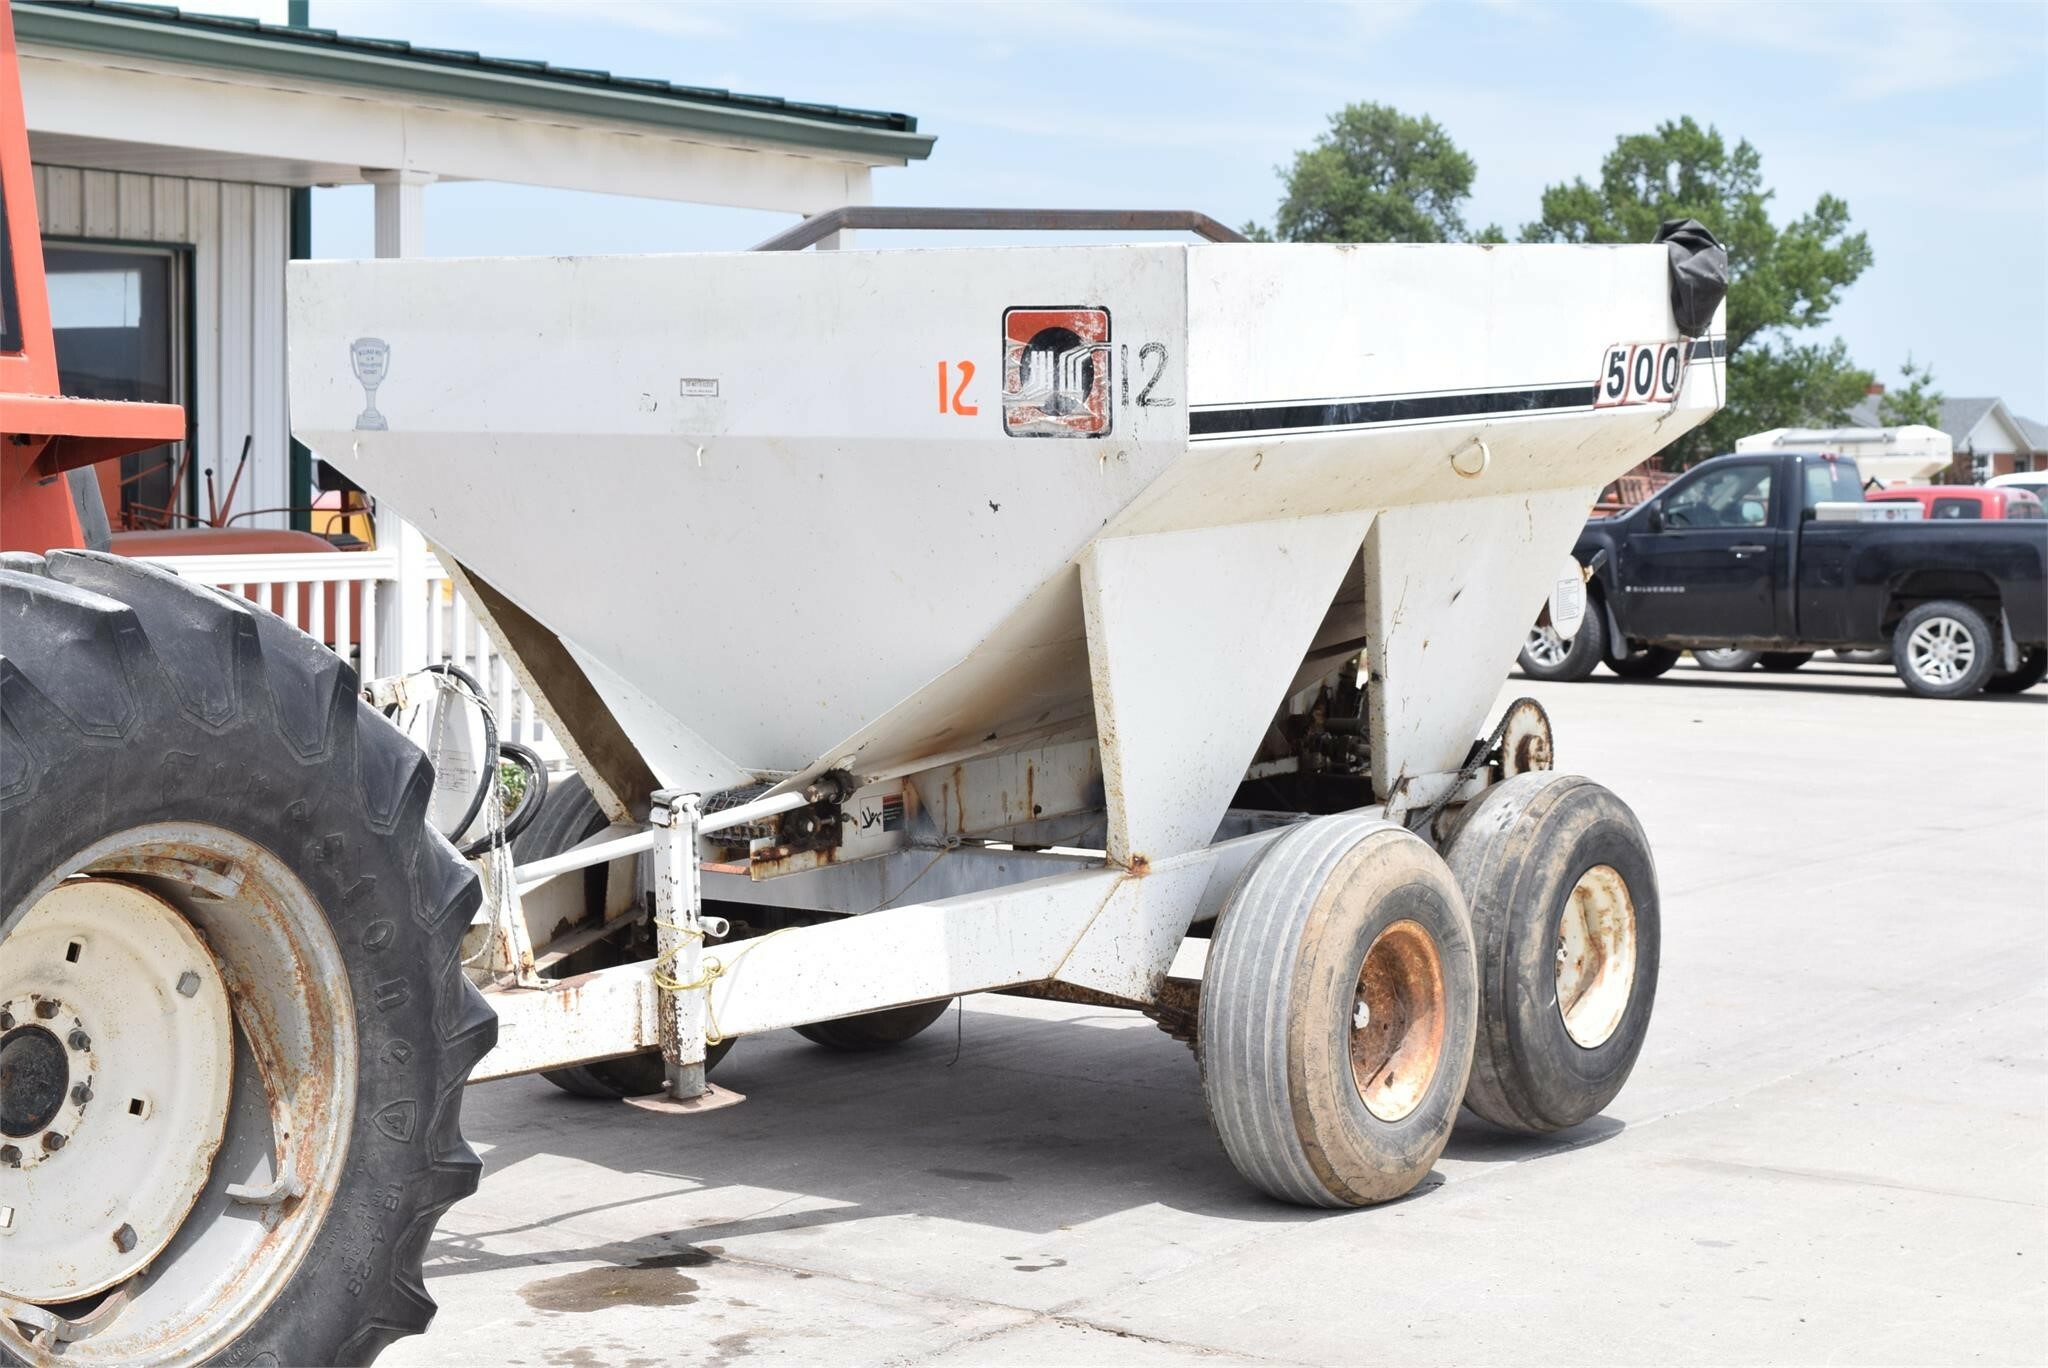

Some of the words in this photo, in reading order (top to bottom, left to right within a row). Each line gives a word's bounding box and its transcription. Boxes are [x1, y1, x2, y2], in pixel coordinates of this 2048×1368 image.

[937, 360, 978, 416] 12
[1120, 342, 1176, 407] 12
[1606, 346, 1679, 398] 500
